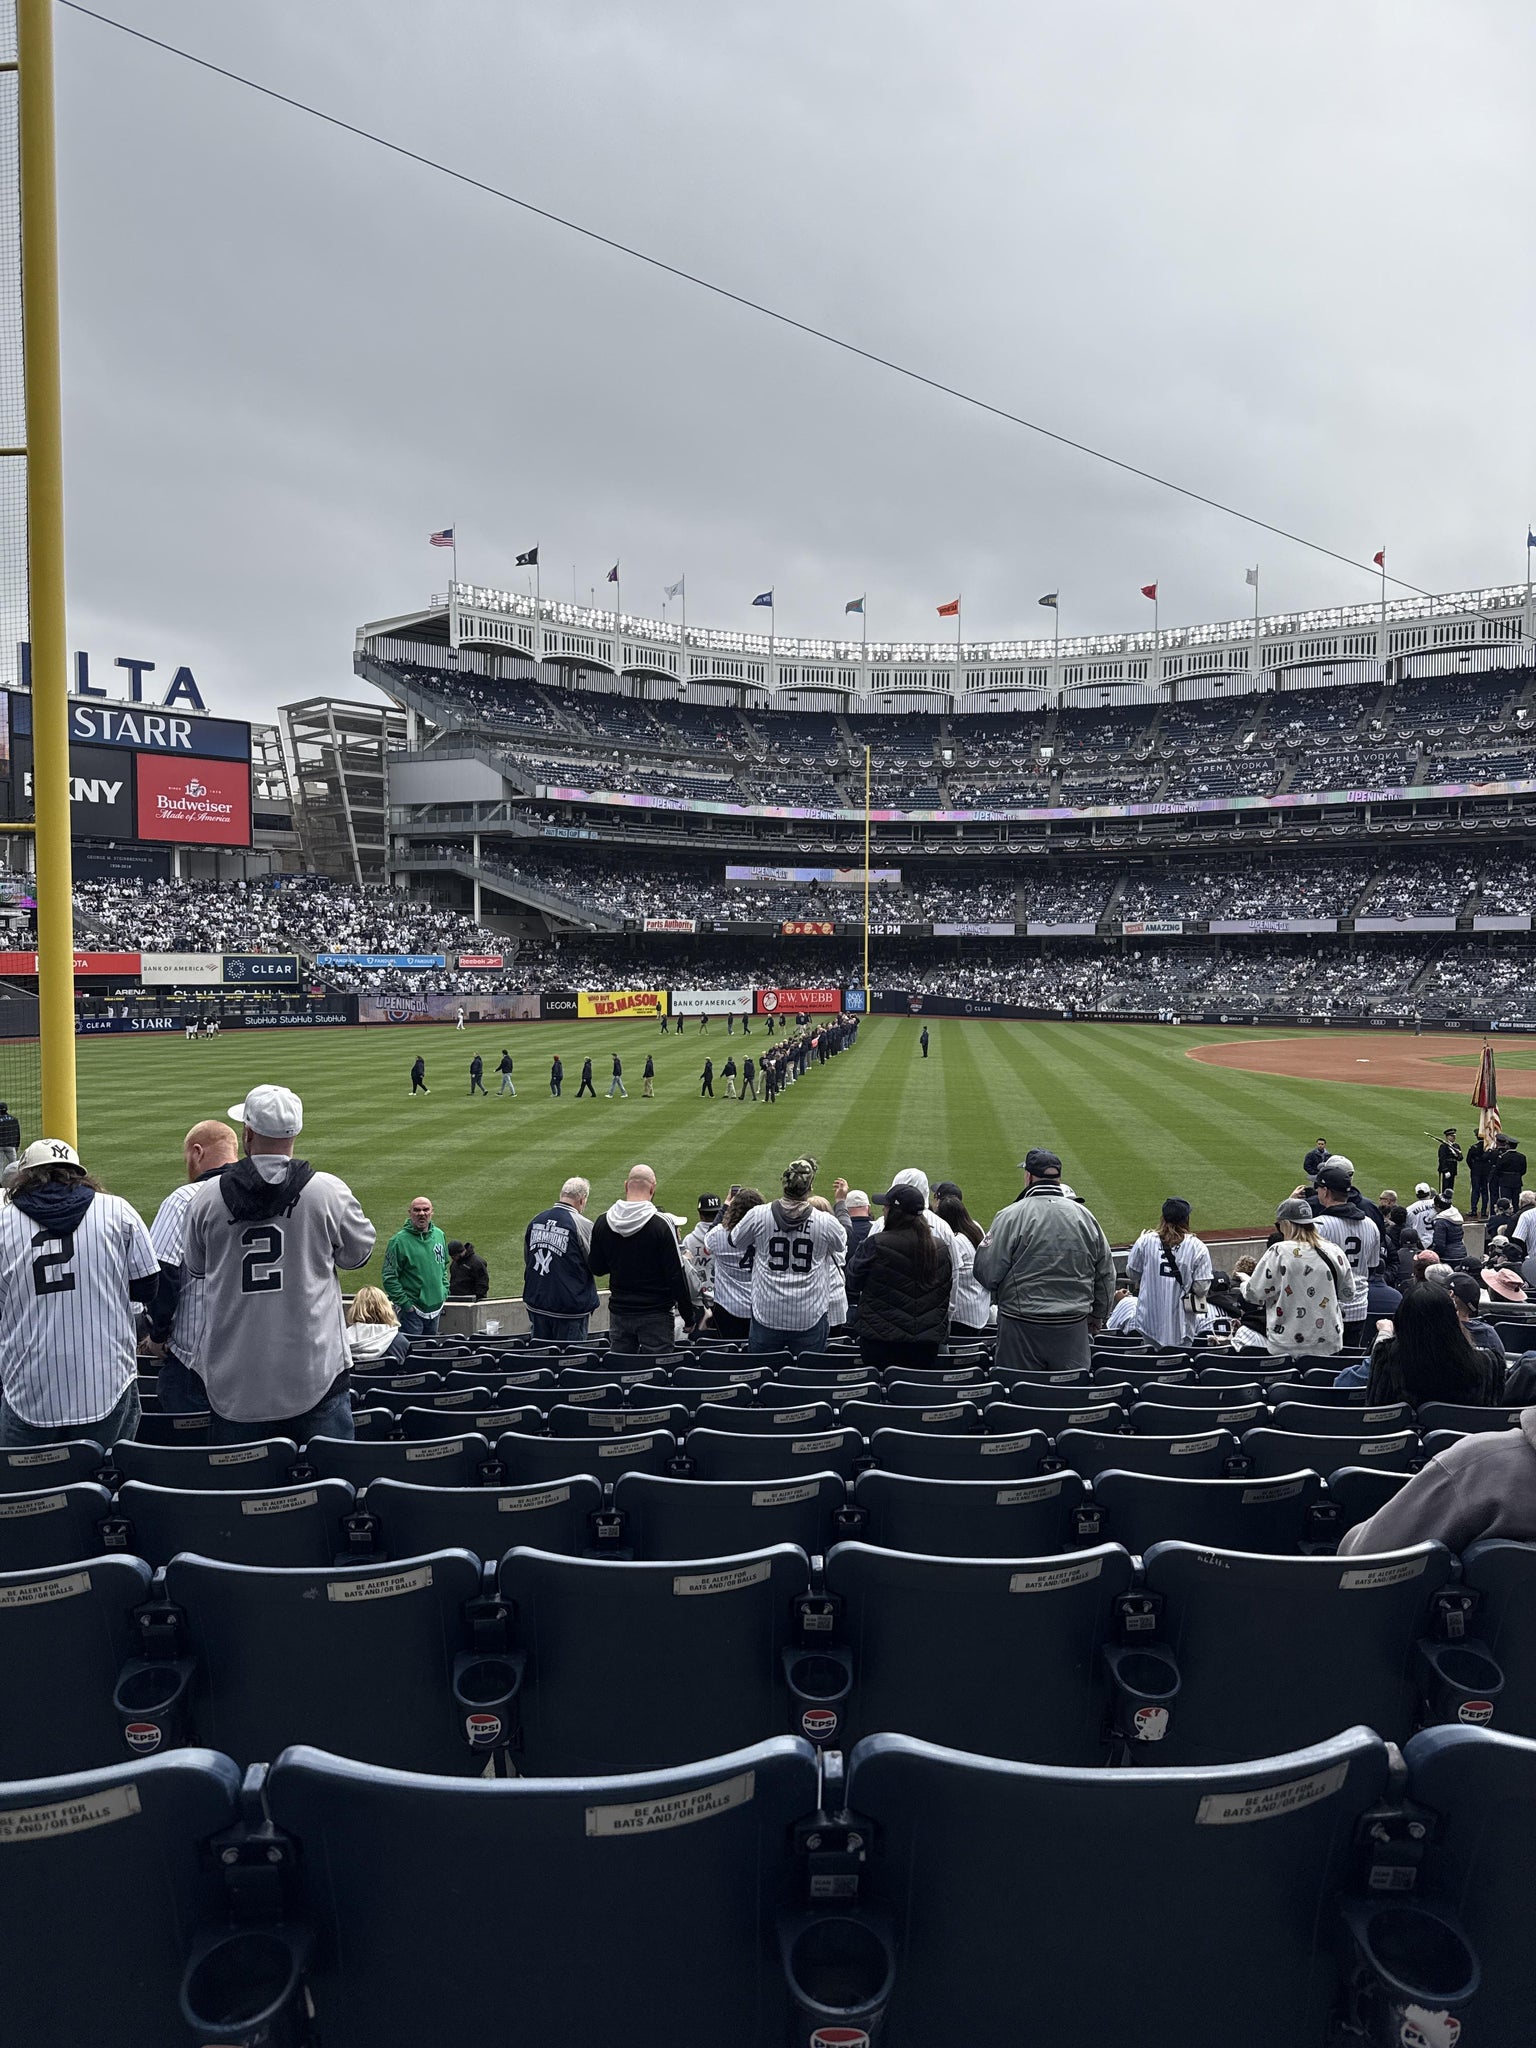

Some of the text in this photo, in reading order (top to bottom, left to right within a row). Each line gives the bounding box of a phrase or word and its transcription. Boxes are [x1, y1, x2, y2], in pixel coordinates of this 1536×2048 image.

[73, 706, 192, 749] STARR
[1363, 751, 1400, 762] VODKA
[1190, 760, 1269, 774] ASPEN VODKA
[157, 795, 232, 814] Budweiser
[155, 809, 230, 822] Made of America
[647, 920, 692, 929] Parts Authority
[868, 925, 900, 935] 1:12 PM
[251, 965, 293, 974] CLEAR
[779, 992, 833, 1003] F.W. WEBB
[131, 1018, 173, 1029] STARR
[245, 1015, 346, 1025] StubHub StubHub StubHub
[708, 1198, 719, 1207] NY
[774, 1219, 814, 1235] JGE
[529, 1229, 569, 1254] CHAMPIONS
[768, 1236, 814, 1273] 99
[1343, 1236, 1362, 1268] 2
[31, 1229, 76, 1296] 2
[240, 1224, 284, 1294] 2
[709, 1579, 736, 1590] AND/OR
[737, 1574, 757, 1584] BALLS
[712, 1573, 732, 1583] ALERT
[1048, 1572, 1067, 1580] ALERT
[1071, 1571, 1089, 1581] BALLS
[20, 1586, 42, 1595] ALERT
[365, 1585, 395, 1595] AND/OR
[395, 1580, 417, 1590] BALLS
[367, 1580, 389, 1589] ALERT
[17, 1592, 48, 1601] AND/OR
[50, 1586, 73, 1596] BALLS
[1461, 1709, 1490, 1718] PEPSI
[471, 1723, 499, 1732] EPSI
[804, 1718, 835, 1728] PEPSI
[127, 1731, 159, 1741] PEPSI
[1245, 1781, 1314, 1806] BE ALERT FOR
[634, 1792, 712, 1818] BE ALERT FOR
[1223, 1784, 1326, 1818] BATS AND/OR BALLS
[20, 1810, 57, 1823] ALERT
[62, 1803, 86, 1816] FOR
[613, 1794, 730, 1829] BATS AND/OR BALLS
[16, 1818, 68, 1834] AND/OR
[70, 1806, 111, 1824] BALLS
